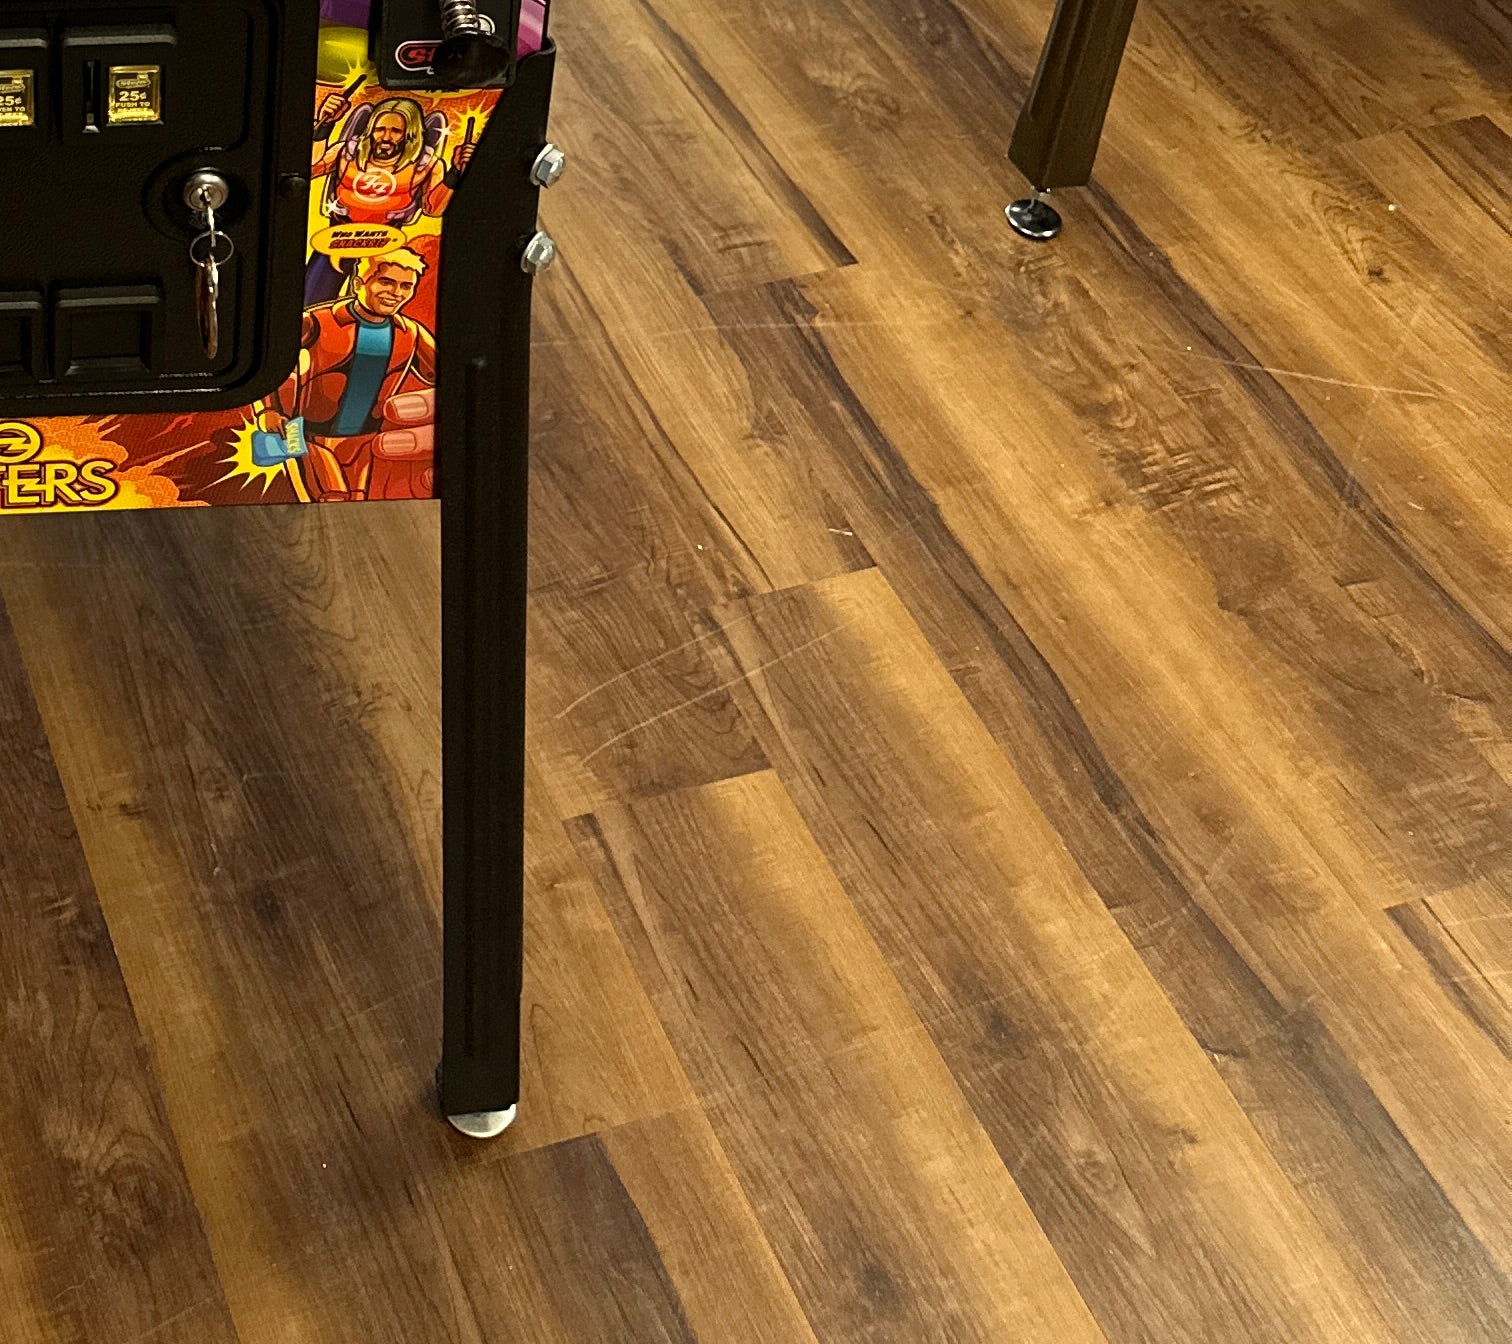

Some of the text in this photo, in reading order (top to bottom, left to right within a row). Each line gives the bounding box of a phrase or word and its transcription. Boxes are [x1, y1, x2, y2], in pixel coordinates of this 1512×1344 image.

[119, 91, 148, 102] 25¢
[331, 229, 389, 238] WHO WANTS
